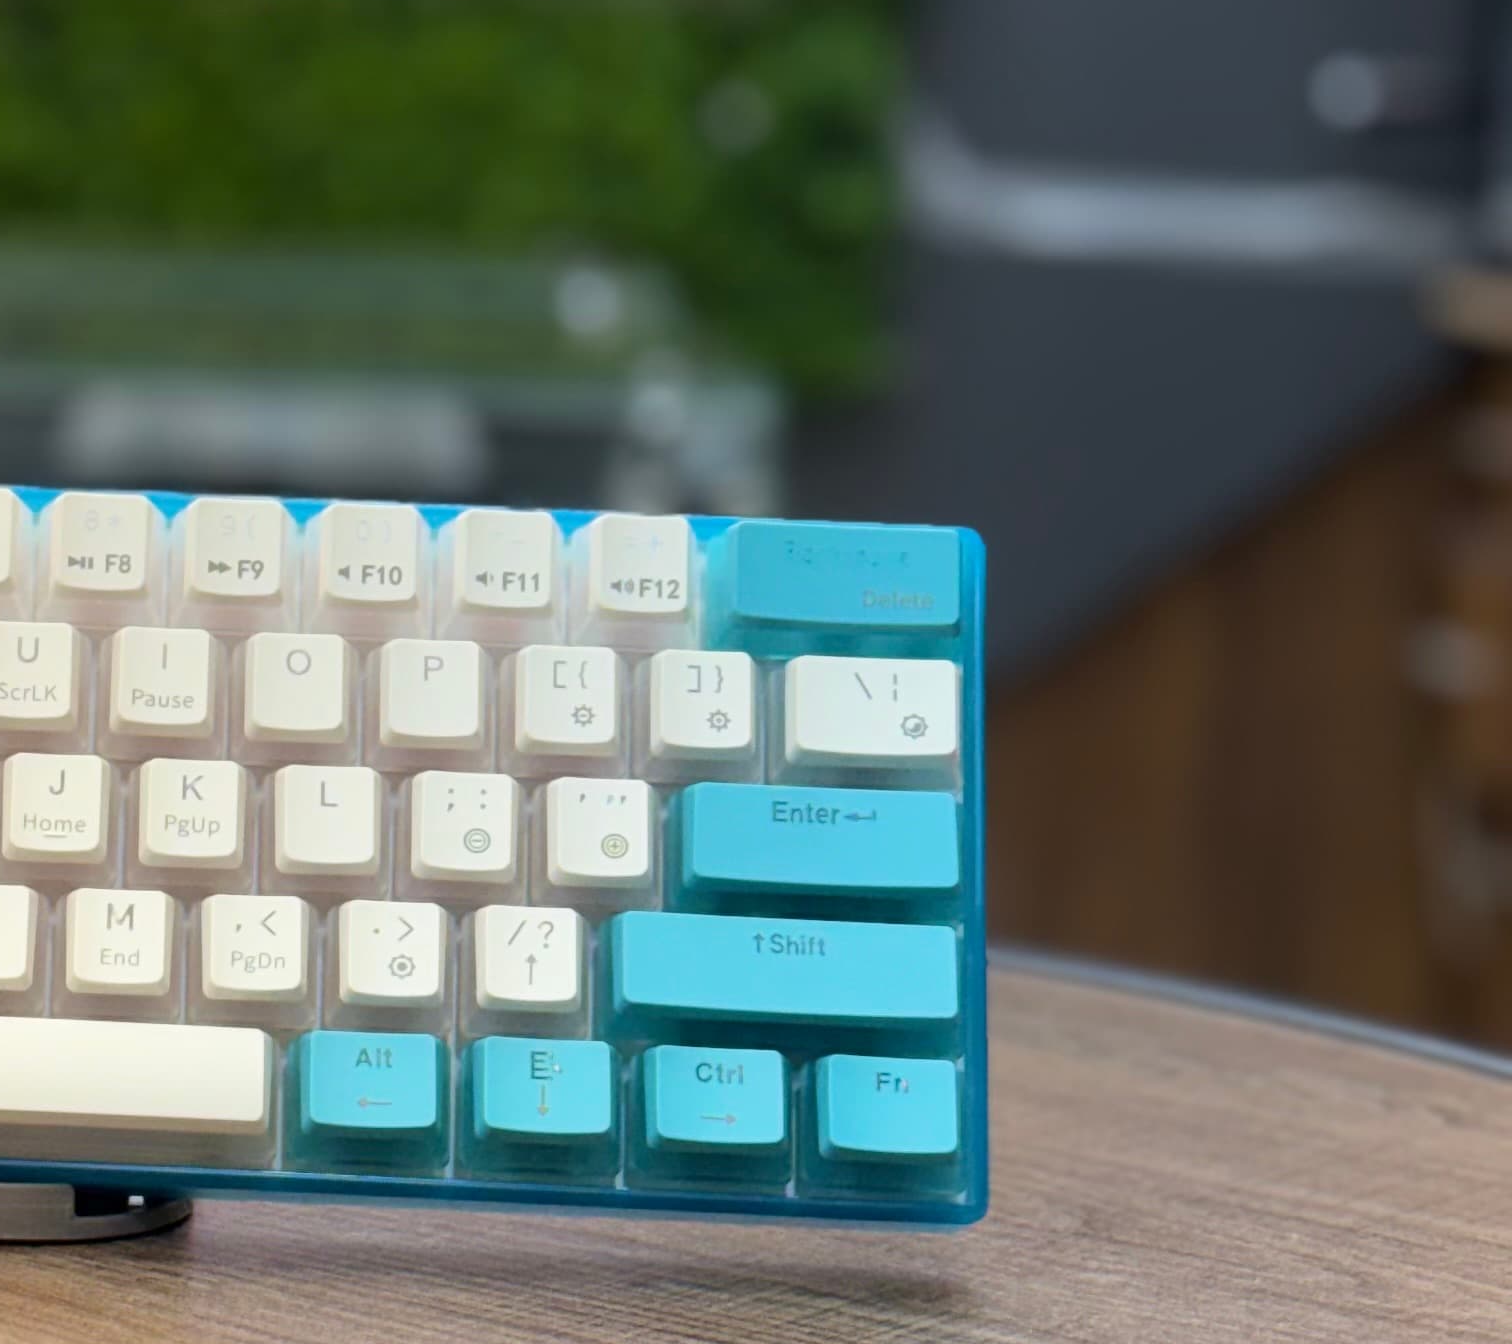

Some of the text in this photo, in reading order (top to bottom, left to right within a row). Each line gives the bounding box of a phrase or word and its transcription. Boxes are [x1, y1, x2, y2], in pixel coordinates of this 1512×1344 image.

[104, 553, 132, 575] F8
[237, 559, 265, 581] F9
[361, 564, 403, 586] F10
[502, 571, 541, 593] F11
[639, 577, 681, 600] F12
[17, 637, 40, 664] U
[286, 649, 312, 676] O
[423, 655, 445, 681] P
[131, 688, 195, 709] Pause
[49, 769, 65, 796] J
[181, 775, 205, 801] K
[320, 781, 339, 808] L
[23, 814, 87, 834] Home
[771, 800, 840, 825] Enter
[164, 816, 221, 837] PgUp
[106, 903, 135, 931] M
[770, 933, 826, 957] Shift
[99, 948, 140, 967] End
[230, 951, 286, 973] PgDn
[355, 1047, 394, 1069] Alt
[695, 1062, 744, 1085] Ctrl
